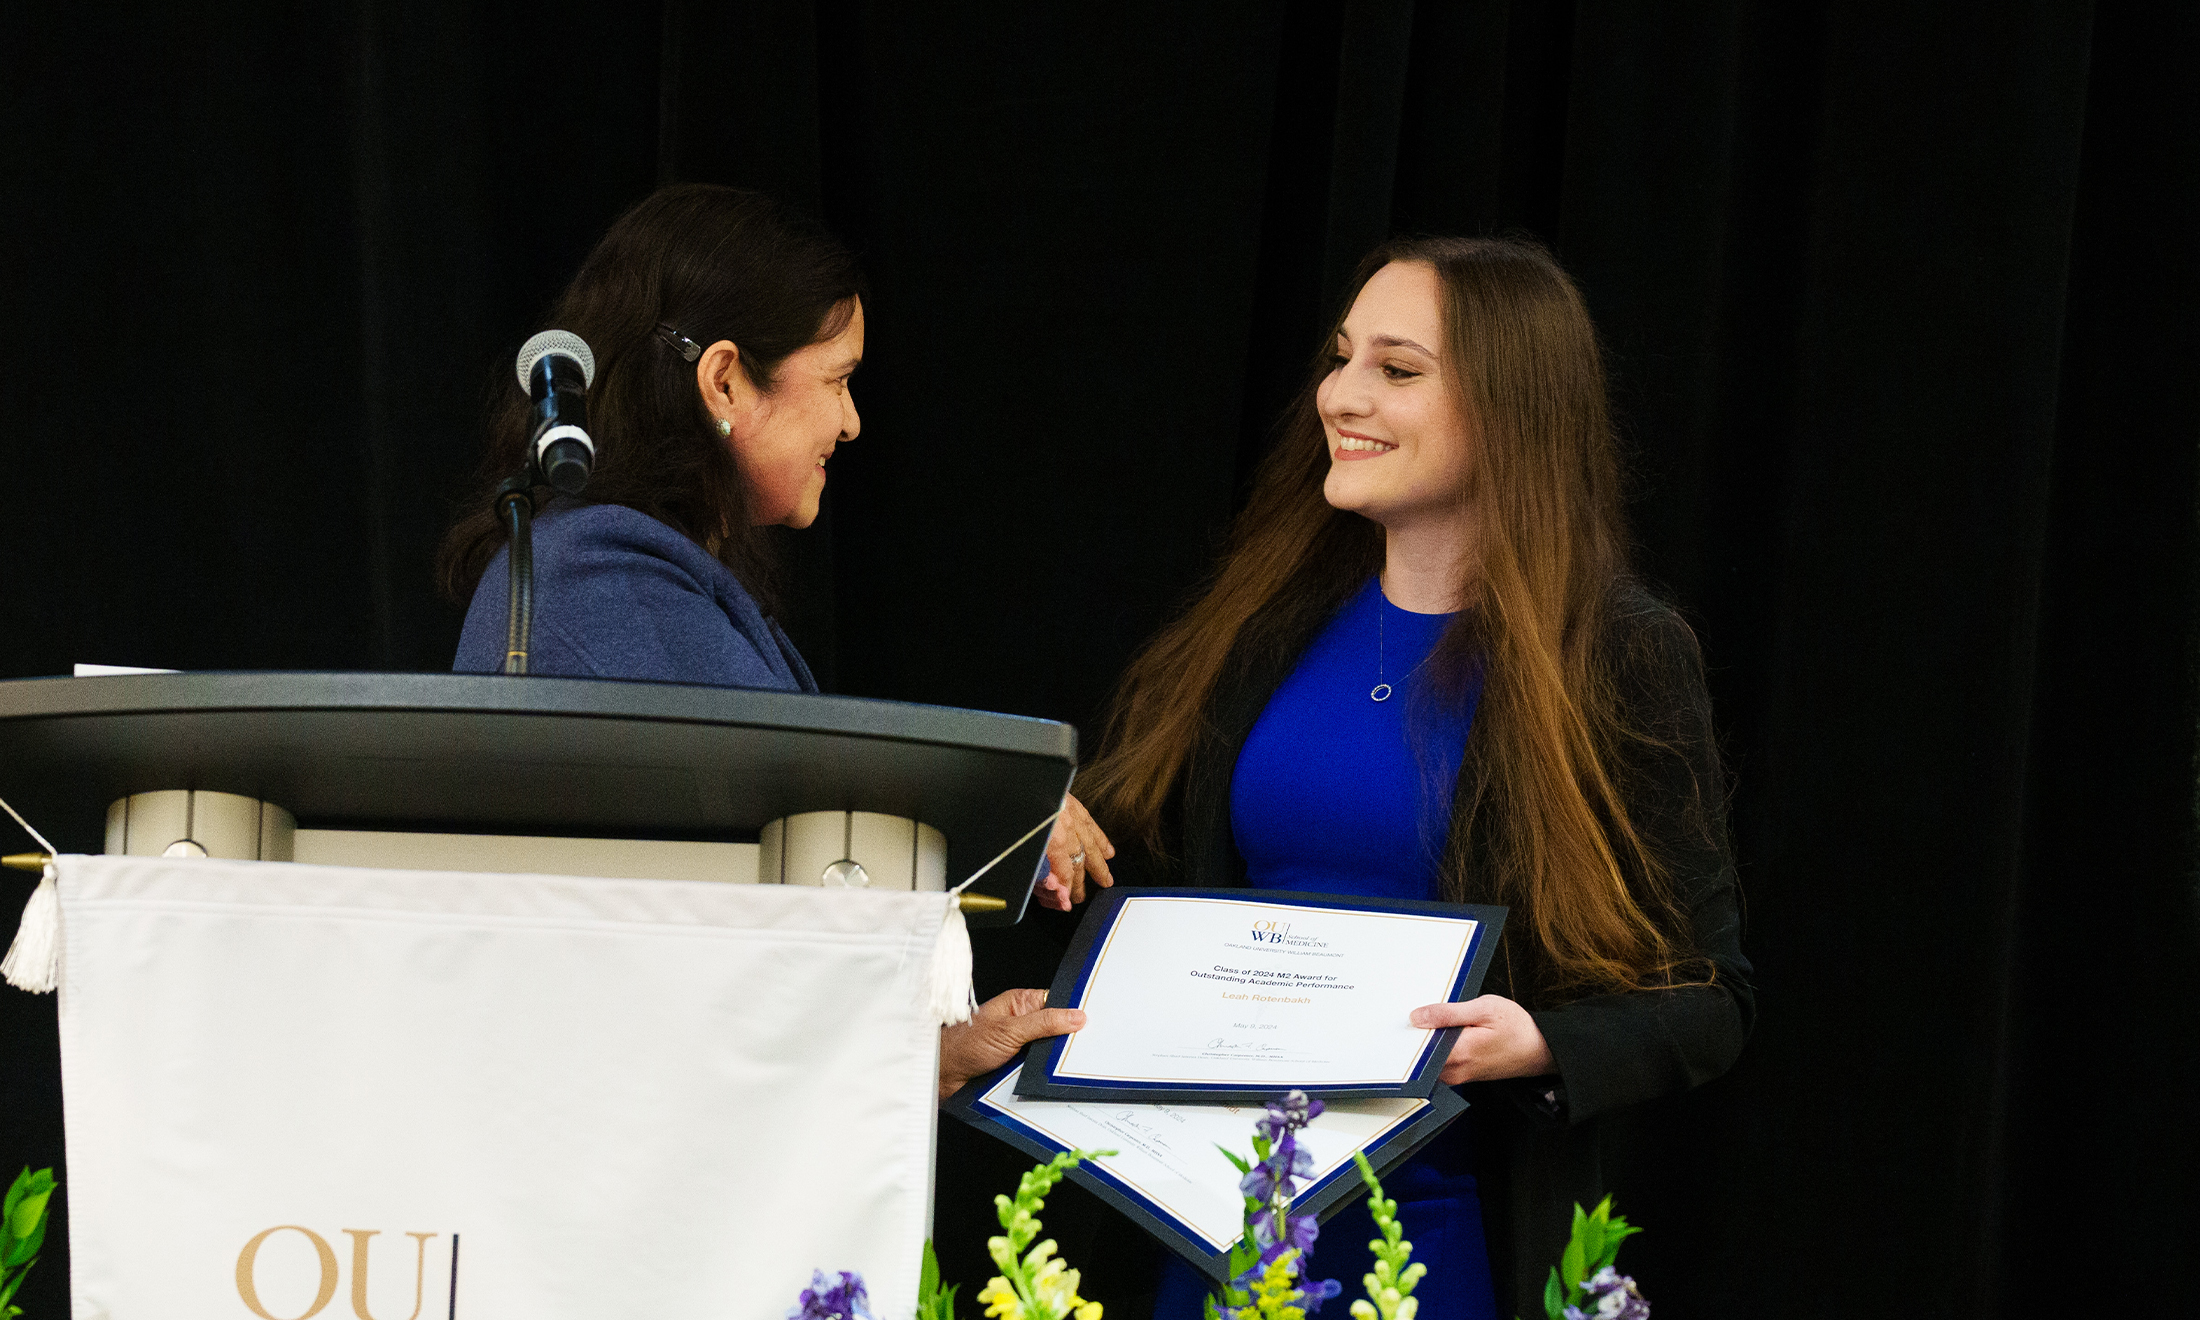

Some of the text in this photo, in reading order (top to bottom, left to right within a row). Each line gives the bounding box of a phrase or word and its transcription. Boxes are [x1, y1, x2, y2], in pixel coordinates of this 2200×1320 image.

[1254, 920, 1287, 933] OU
[1251, 930, 1282, 944] WB
[1285, 939, 1329, 948] MEDICINE
[1224, 942, 1252, 951] OAKLAND
[1190, 970, 1355, 990] Outstanding Academic Performance
[1213, 965, 1239, 975] Class
[1252, 969, 1275, 978] 2024
[1276, 972, 1292, 980] M2
[1292, 973, 1322, 981] Award
[1324, 974, 1338, 982] for
[1221, 991, 1311, 1004] Leah Rotenbakh
[1232, 1022, 1248, 1030] May
[235, 1224, 438, 1320] OU
